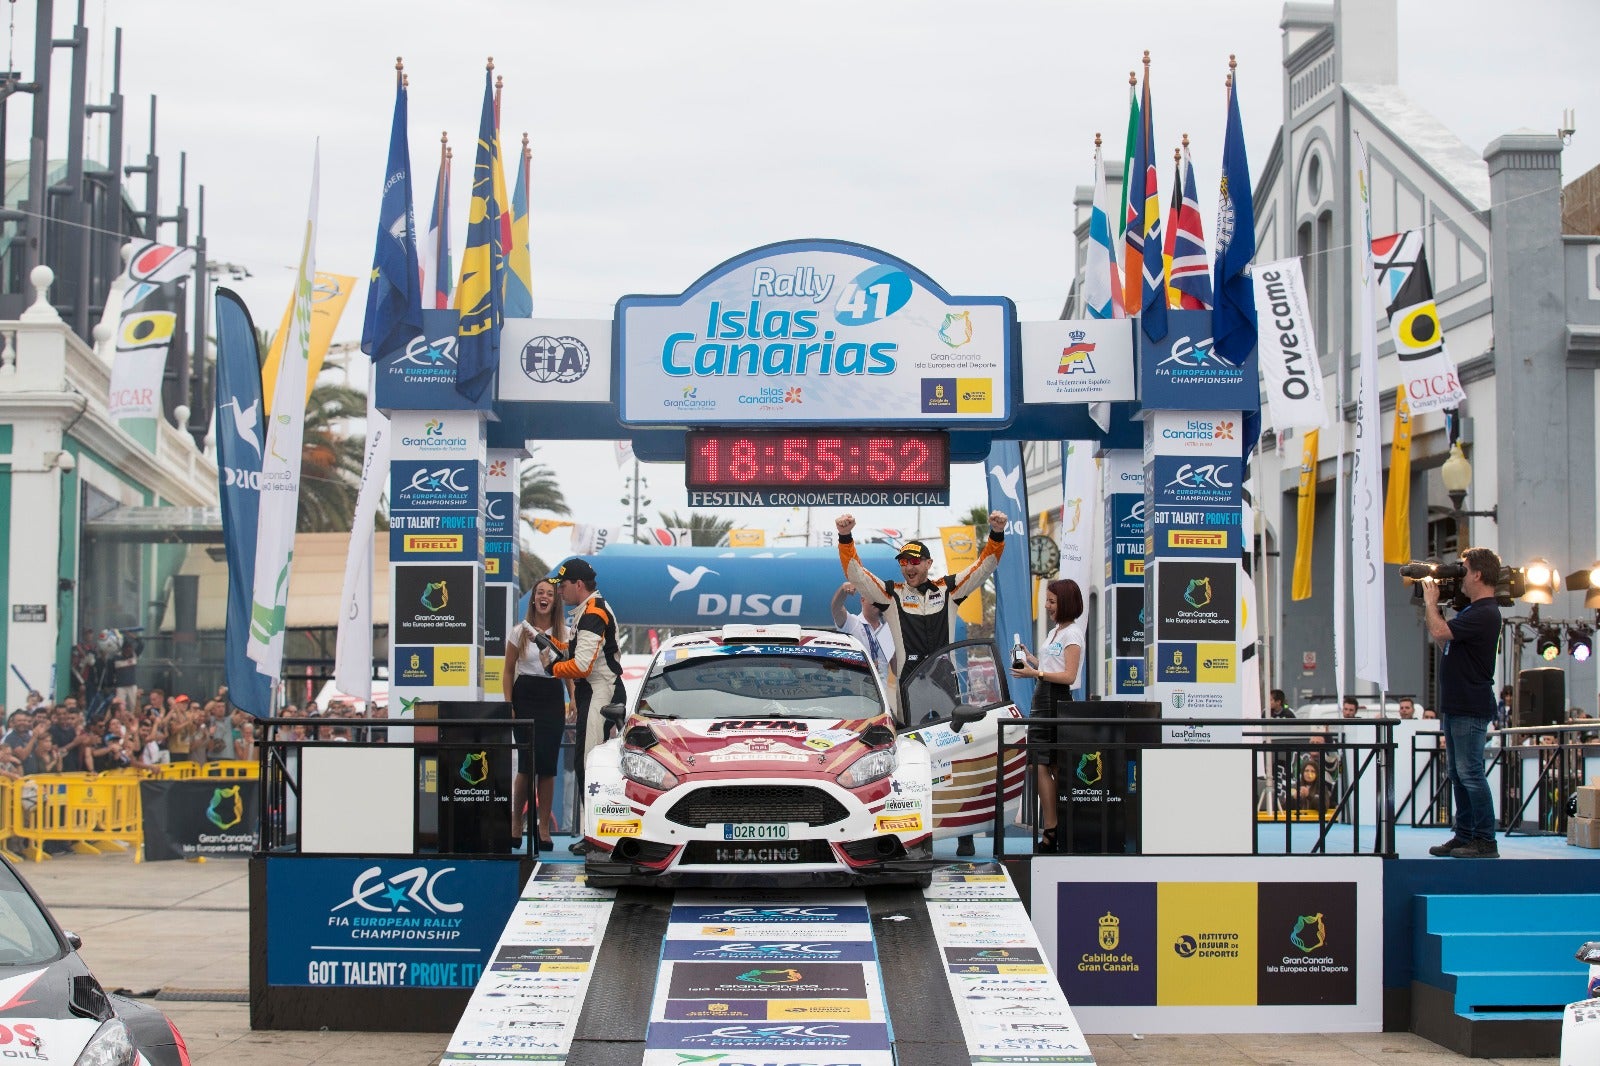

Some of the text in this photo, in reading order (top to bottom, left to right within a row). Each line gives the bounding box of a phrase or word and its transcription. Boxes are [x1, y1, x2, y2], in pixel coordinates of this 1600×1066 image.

[752, 266, 835, 303] Rally
[835, 283, 891, 320] 41
[706, 300, 819, 341] Islas
[1262, 270, 1309, 401] Orvecame
[661, 330, 899, 376] Canarias
[1171, 376, 1244, 384] CHAMPIONSHIP
[760, 387, 784, 396] Islas
[738, 395, 784, 404] Canarias
[1187, 420, 1213, 430] Islas
[1162, 429, 1213, 440] Canarias
[402, 437, 467, 446] GranCanaria
[700, 439, 930, 481] 18:55:52
[692, 491, 945, 506] FESTINA CRONOMETRADOR OFICIAL
[390, 516, 405, 529] GOT
[406, 516, 440, 528] TALENT?
[442, 516, 466, 528] PROVE
[1154, 512, 1242, 526] GOT TALENT? PROVE IT!
[410, 538, 458, 548] PIRELLI
[1174, 534, 1222, 545] PIRELLI
[697, 593, 802, 616] DISA
[1178, 610, 1218, 618] GranCanaria
[707, 720, 808, 732] RPM
[600, 822, 638, 833] PIRELLI
[880, 817, 918, 830] PIRELLI
[734, 826, 786, 838] 02R 0110
[331, 866, 464, 914] ERC
[328, 916, 462, 928] FIA EUROPEAN RALLY
[351, 928, 460, 940] CHAMPIONSHIP
[1198, 933, 1239, 941] INSTITUTO
[1198, 942, 1230, 950] INSULAR
[1082, 953, 1133, 963] Cabildo de
[1198, 950, 1239, 958] DEPORTES
[1282, 956, 1334, 964] GranCanaria
[1078, 962, 1139, 972] Gran Canaria
[1280, 966, 1307, 974] Europea
[1320, 966, 1348, 974] Deporte
[308, 960, 482, 986] GOT TALENT? PROVE IT!
